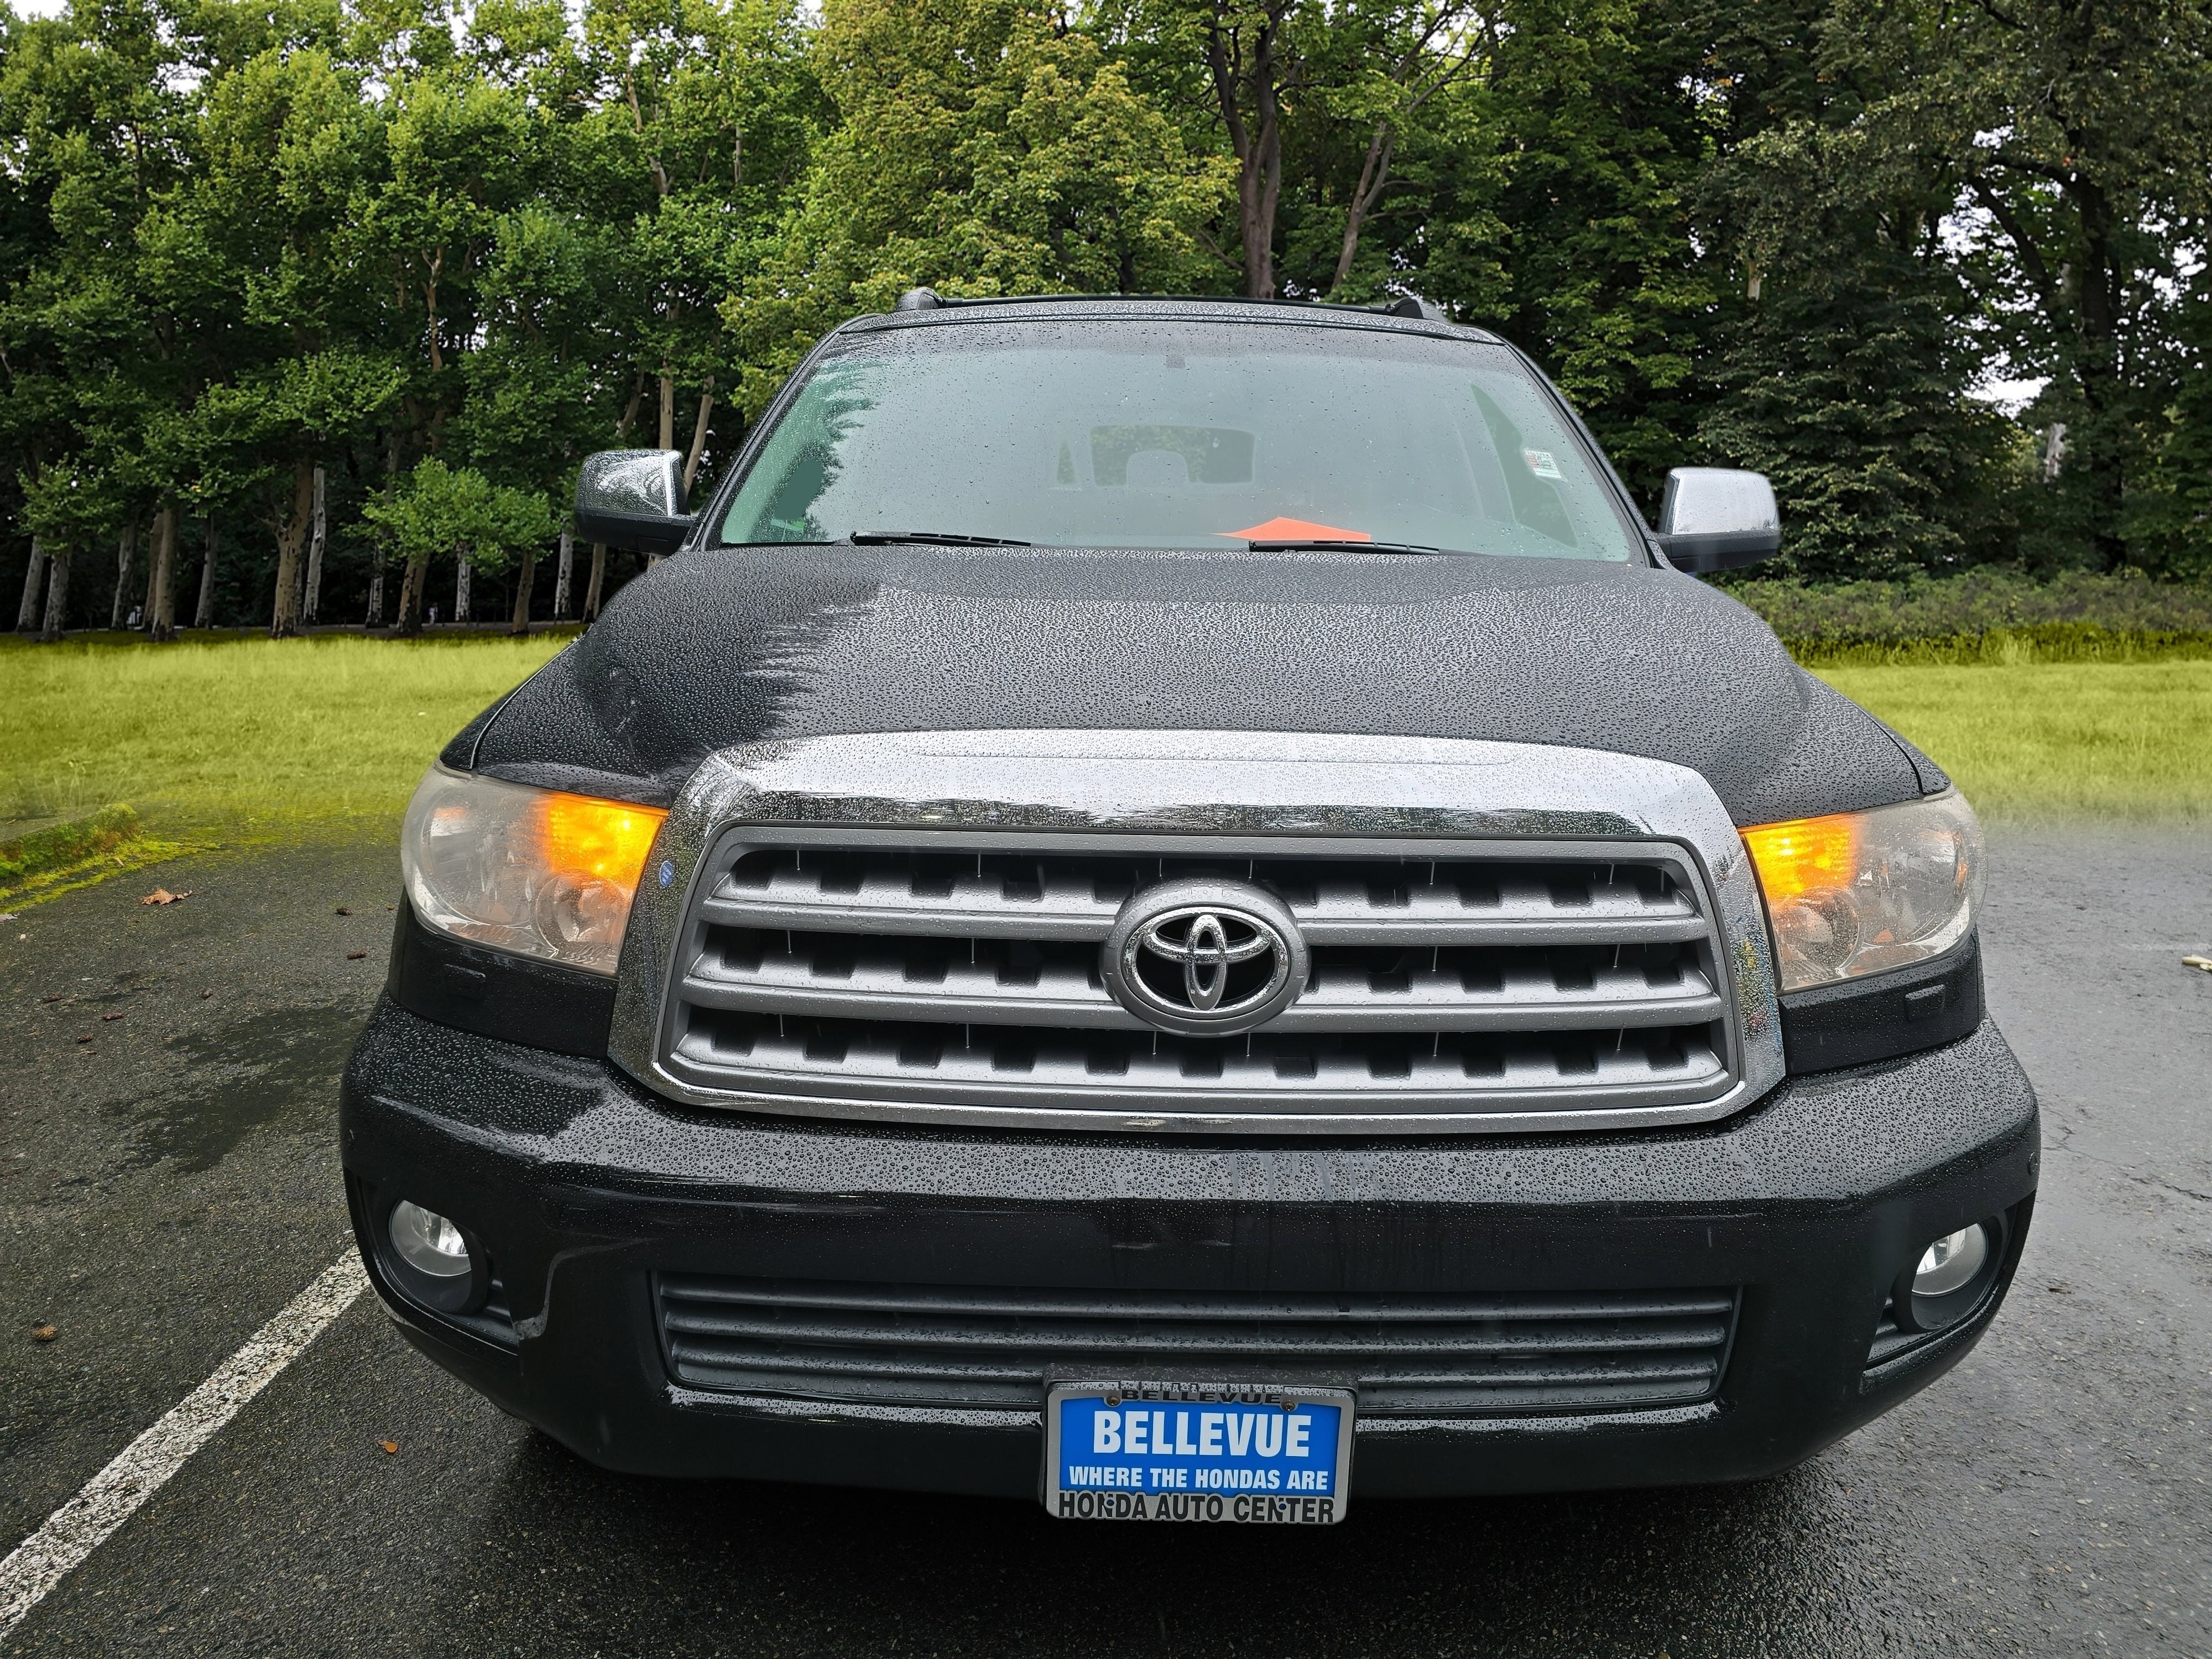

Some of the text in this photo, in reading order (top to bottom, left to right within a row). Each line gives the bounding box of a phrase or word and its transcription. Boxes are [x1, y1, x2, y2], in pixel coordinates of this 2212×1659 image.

[1121, 1389, 1282, 1404] BELLEVUE
[1093, 1410, 1312, 1457] BELLEVUE
[1069, 1466, 1328, 1490] WHERE THE HONDAS ARE
[1058, 1492, 1334, 1523] HONDA AUTO CENTER
